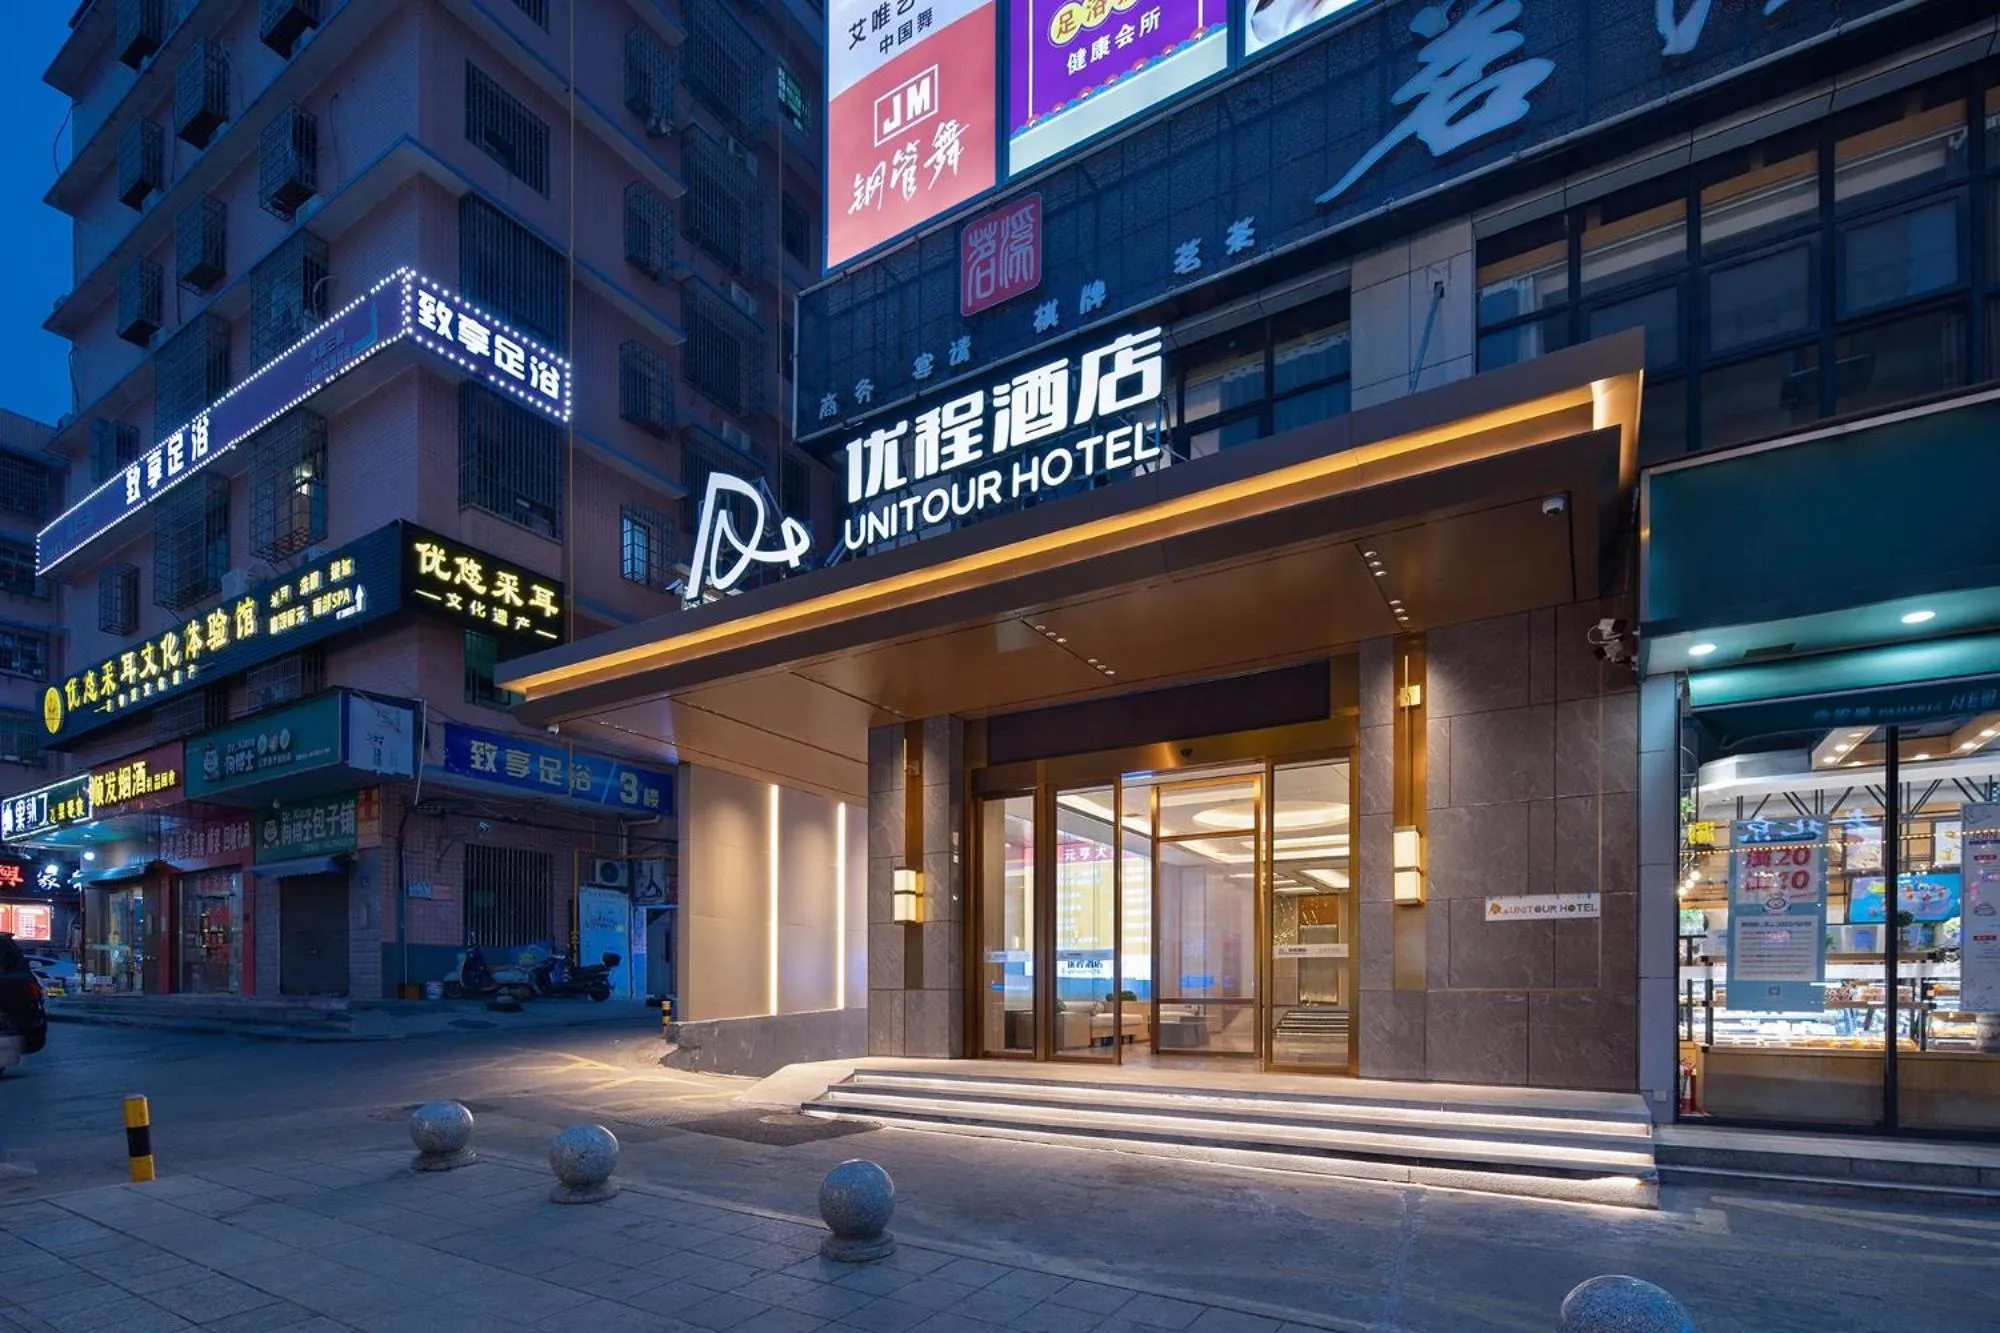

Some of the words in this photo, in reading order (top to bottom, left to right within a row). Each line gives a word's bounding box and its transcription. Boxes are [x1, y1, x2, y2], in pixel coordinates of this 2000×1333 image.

[879, 7, 933, 54] 中国舞
[1066, 6, 1161, 76] 健康会所
[883, 76, 931, 132] JM
[848, 119, 970, 216] 钢管舞
[1033, 278, 1108, 334] 棋牌
[416, 289, 561, 400] 致享足浴
[846, 326, 1163, 503] 优程酒店
[125, 415, 210, 505] 致享足浴
[845, 469, 1002, 550] UNITOUR
[1011, 422, 1162, 499] HOTEL
[414, 542, 560, 617] 优悠采耳
[445, 592, 531, 630] 文化遗产
[64, 597, 258, 713] 优悠采耳文化体验馆
[91, 760, 147, 807] 顺发烟酒
[470, 739, 592, 792] 致享足浴
[1560, 902, 1598, 914] HOTEL
